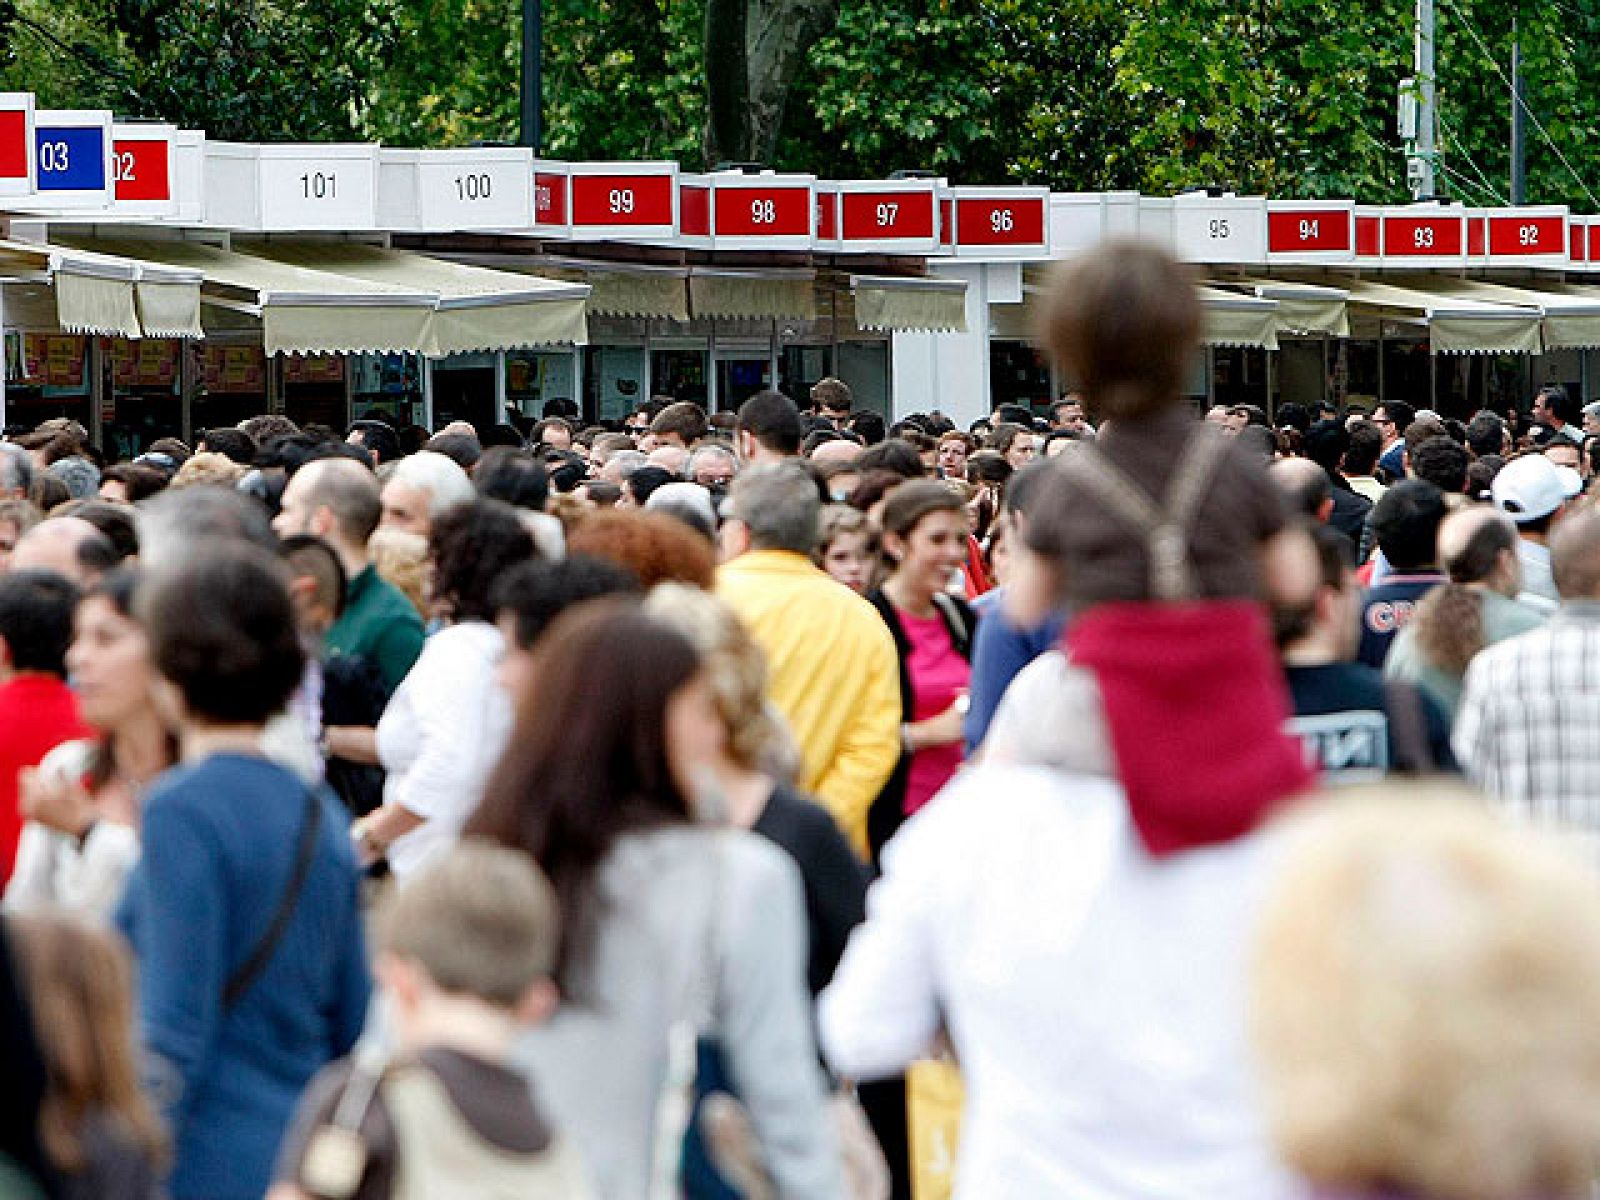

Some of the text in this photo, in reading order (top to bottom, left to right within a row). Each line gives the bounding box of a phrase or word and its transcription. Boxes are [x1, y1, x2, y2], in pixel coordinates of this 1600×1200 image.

[300, 173, 335, 199] 101
[455, 175, 491, 200] 100
[609, 189, 634, 214] 99
[751, 199, 776, 224] 98
[876, 202, 899, 226] 97
[990, 209, 1014, 233] 96
[1209, 219, 1231, 239] 95
[1299, 219, 1319, 241] 94
[1414, 226, 1434, 248] 93
[1519, 224, 1539, 246] 92
